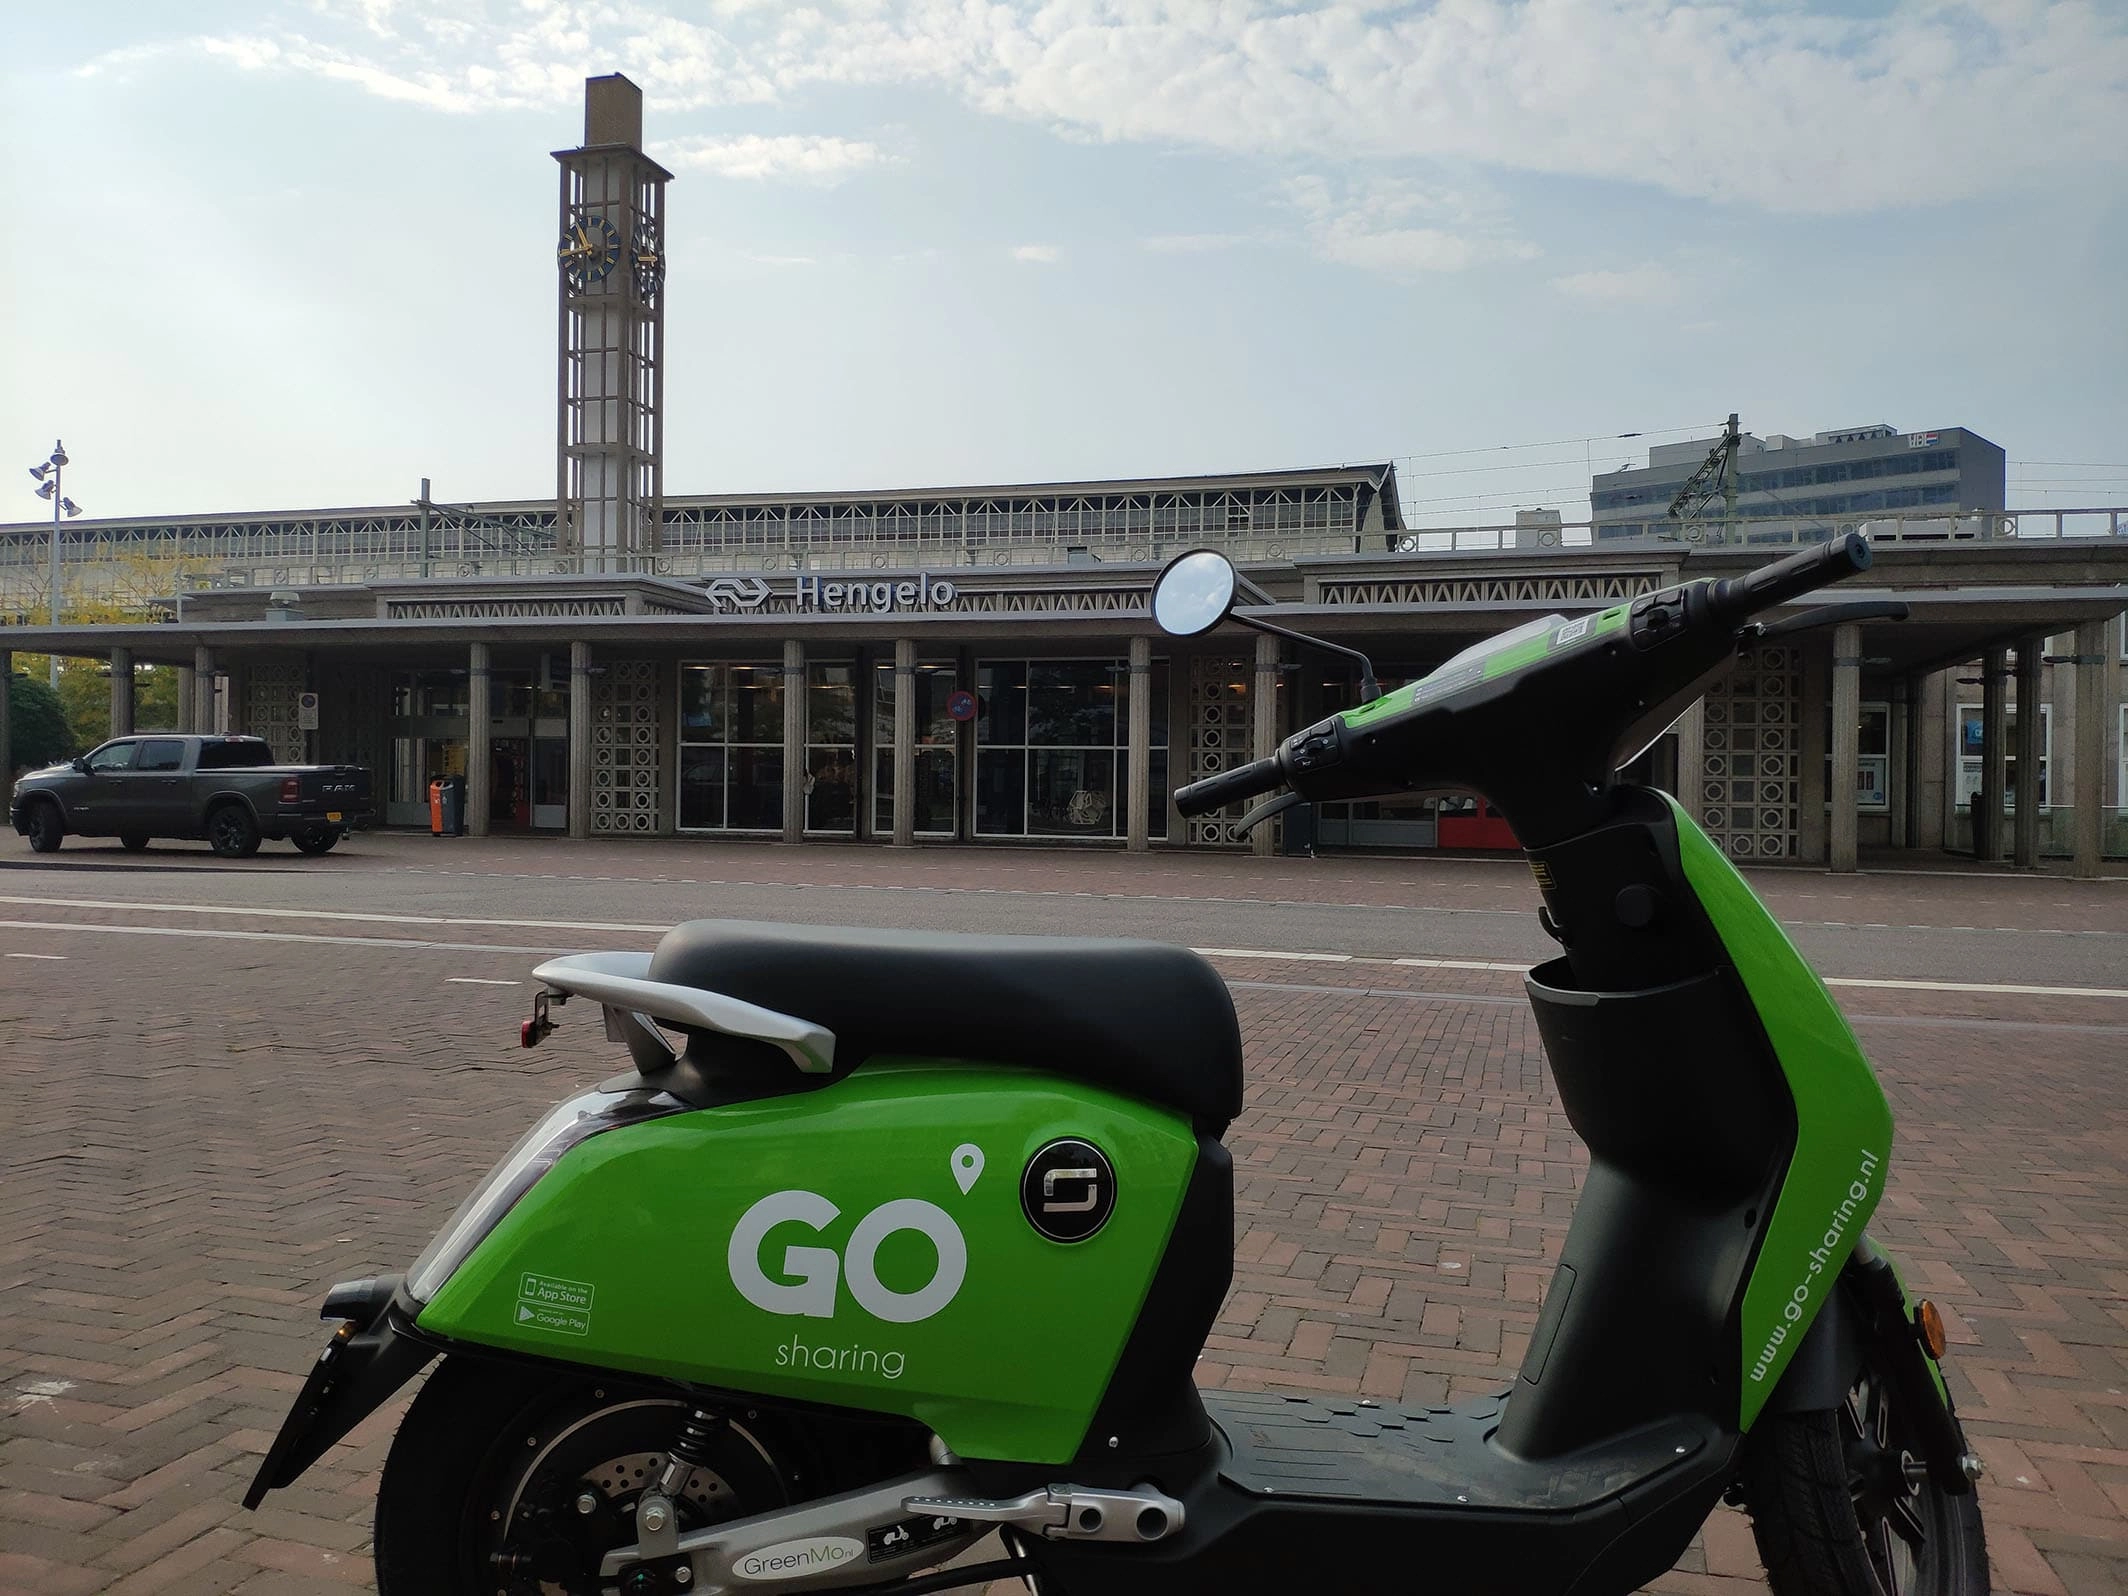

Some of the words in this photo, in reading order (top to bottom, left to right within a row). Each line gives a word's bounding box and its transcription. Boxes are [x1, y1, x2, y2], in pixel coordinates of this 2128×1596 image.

[796, 572, 956, 614] Hengelo
[728, 1190, 967, 1323] GO
[1750, 1149, 1879, 1382] www.go-sharing.nl
[537, 1287, 559, 1301] App
[560, 1291, 587, 1304] Store
[539, 1281, 567, 1291] Available
[536, 1313, 568, 1327] Google
[569, 1318, 587, 1330] Play
[775, 1334, 905, 1380] sharing
